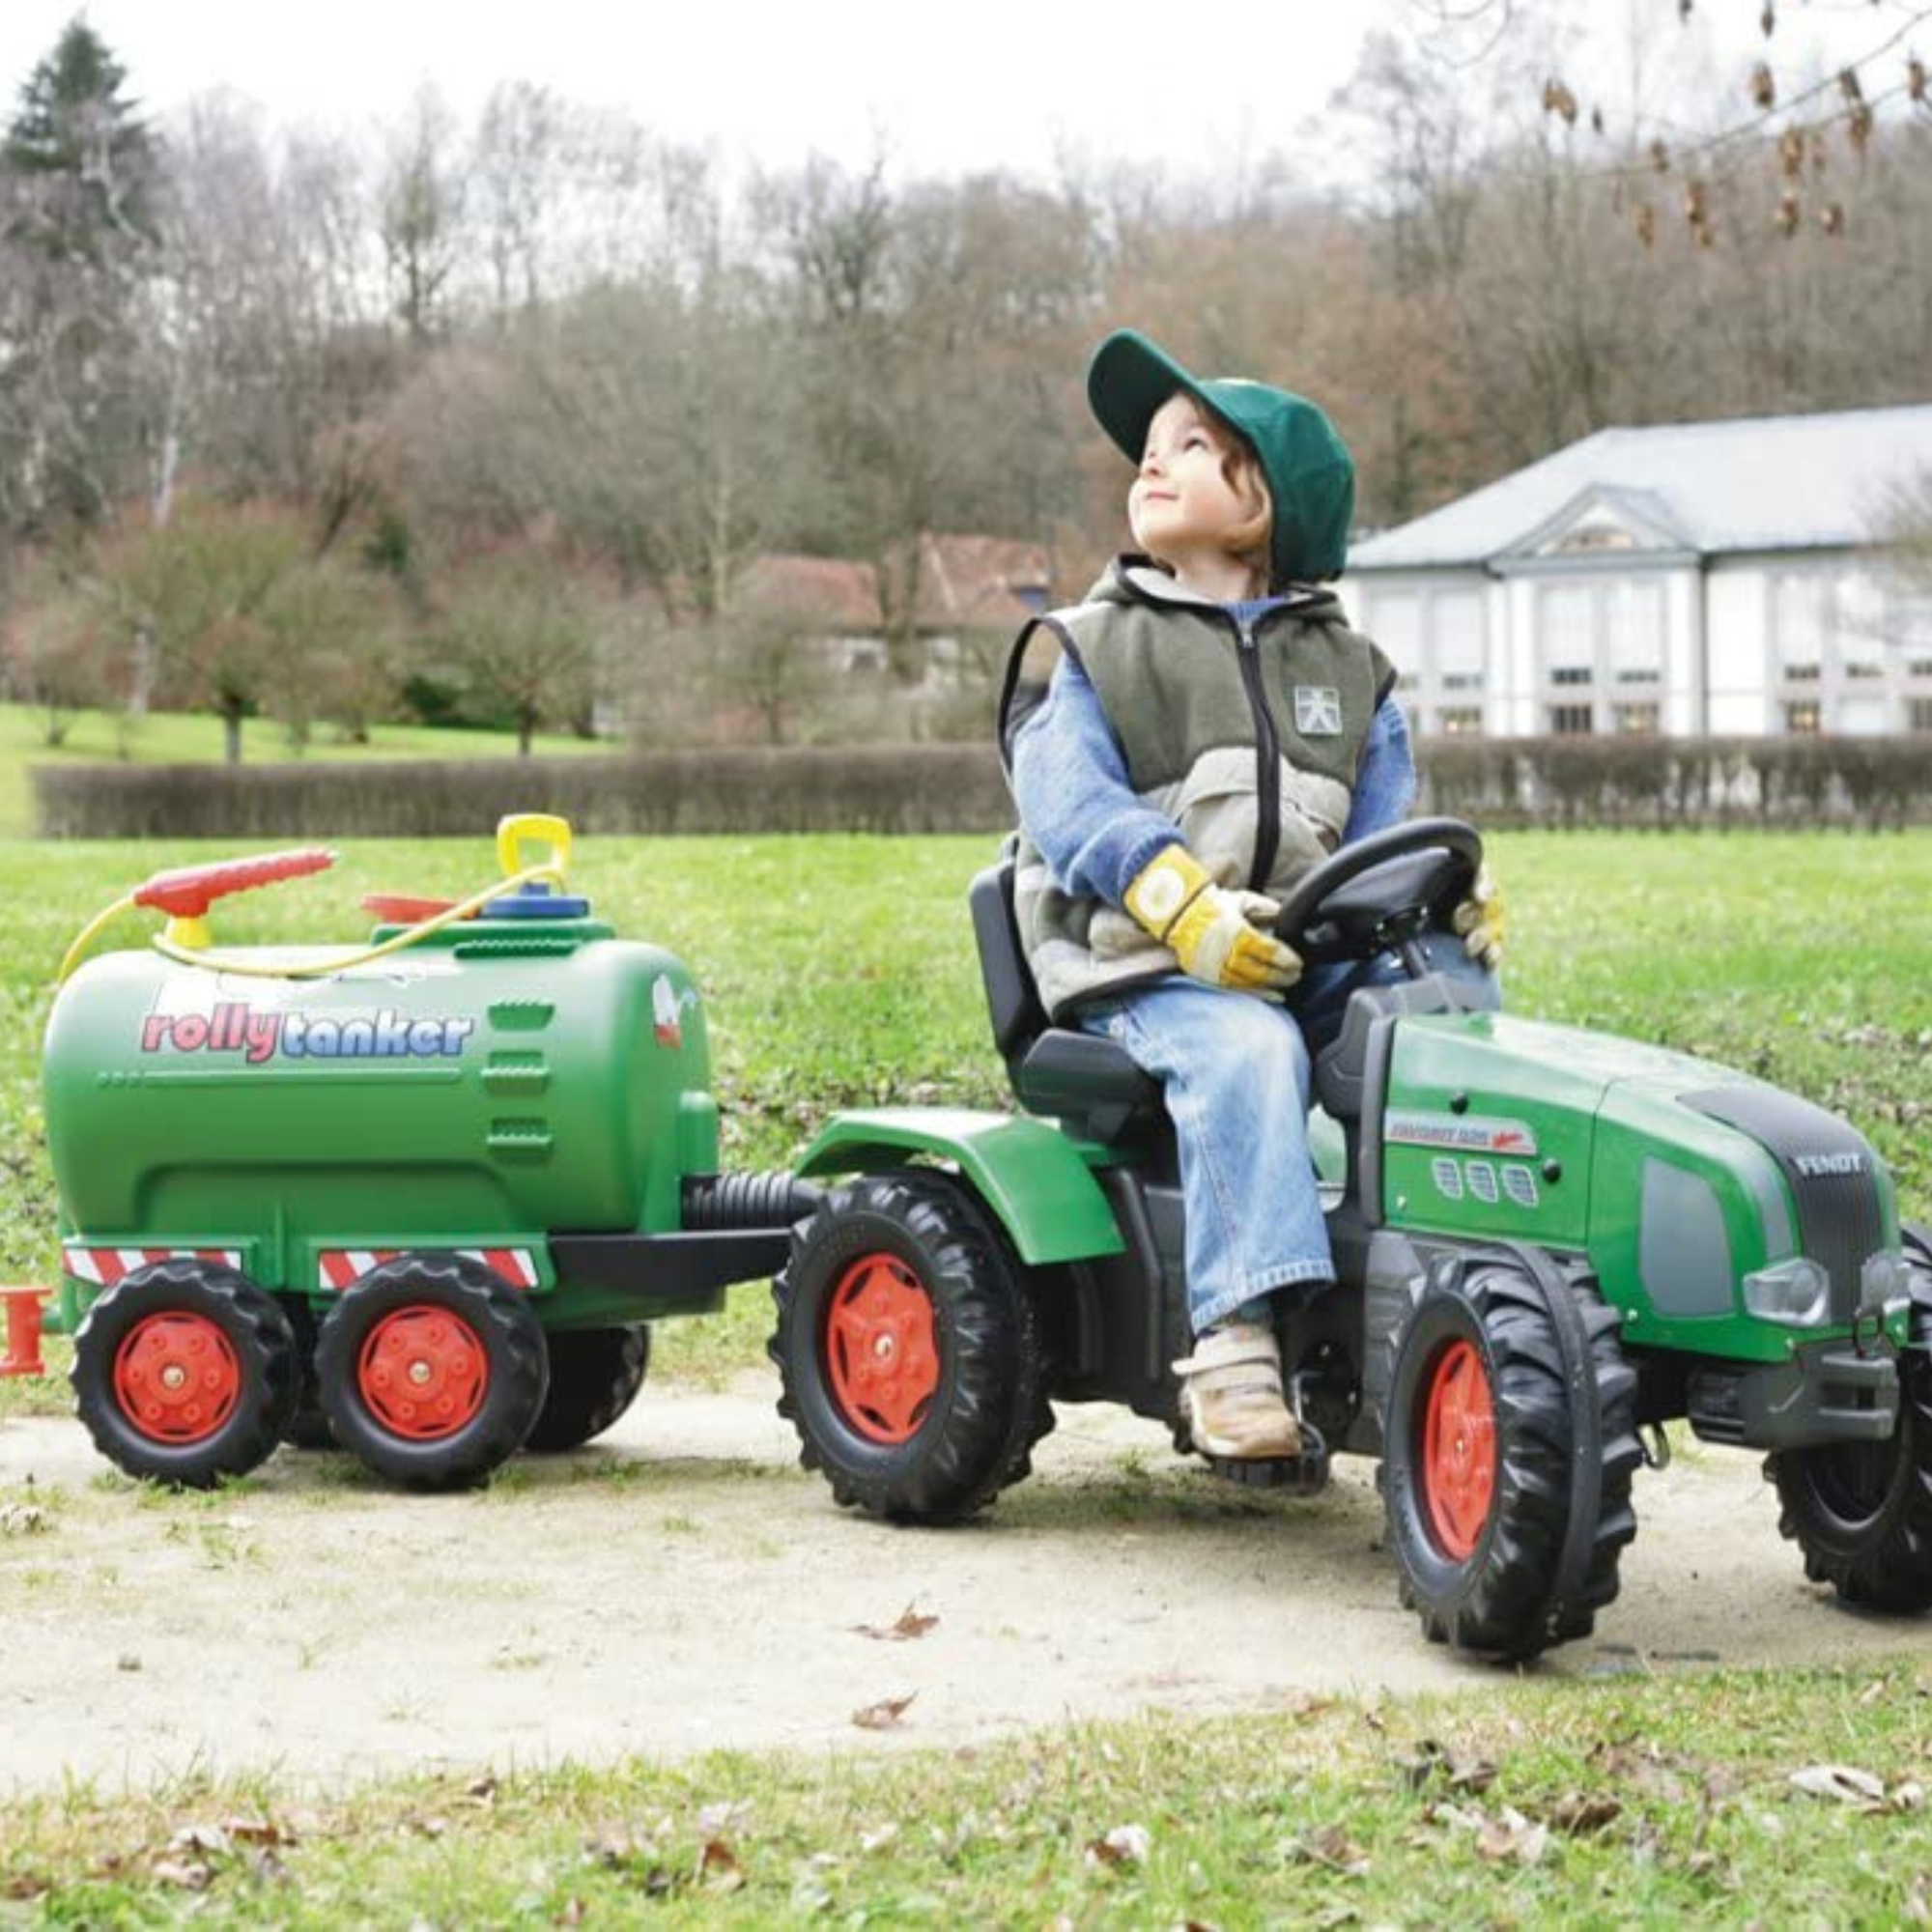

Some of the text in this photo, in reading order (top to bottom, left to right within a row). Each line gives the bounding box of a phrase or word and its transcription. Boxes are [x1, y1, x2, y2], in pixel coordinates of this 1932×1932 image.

[142, 1002, 473, 1064] rolly tanker
[1795, 1152, 1861, 1176] FENDT
